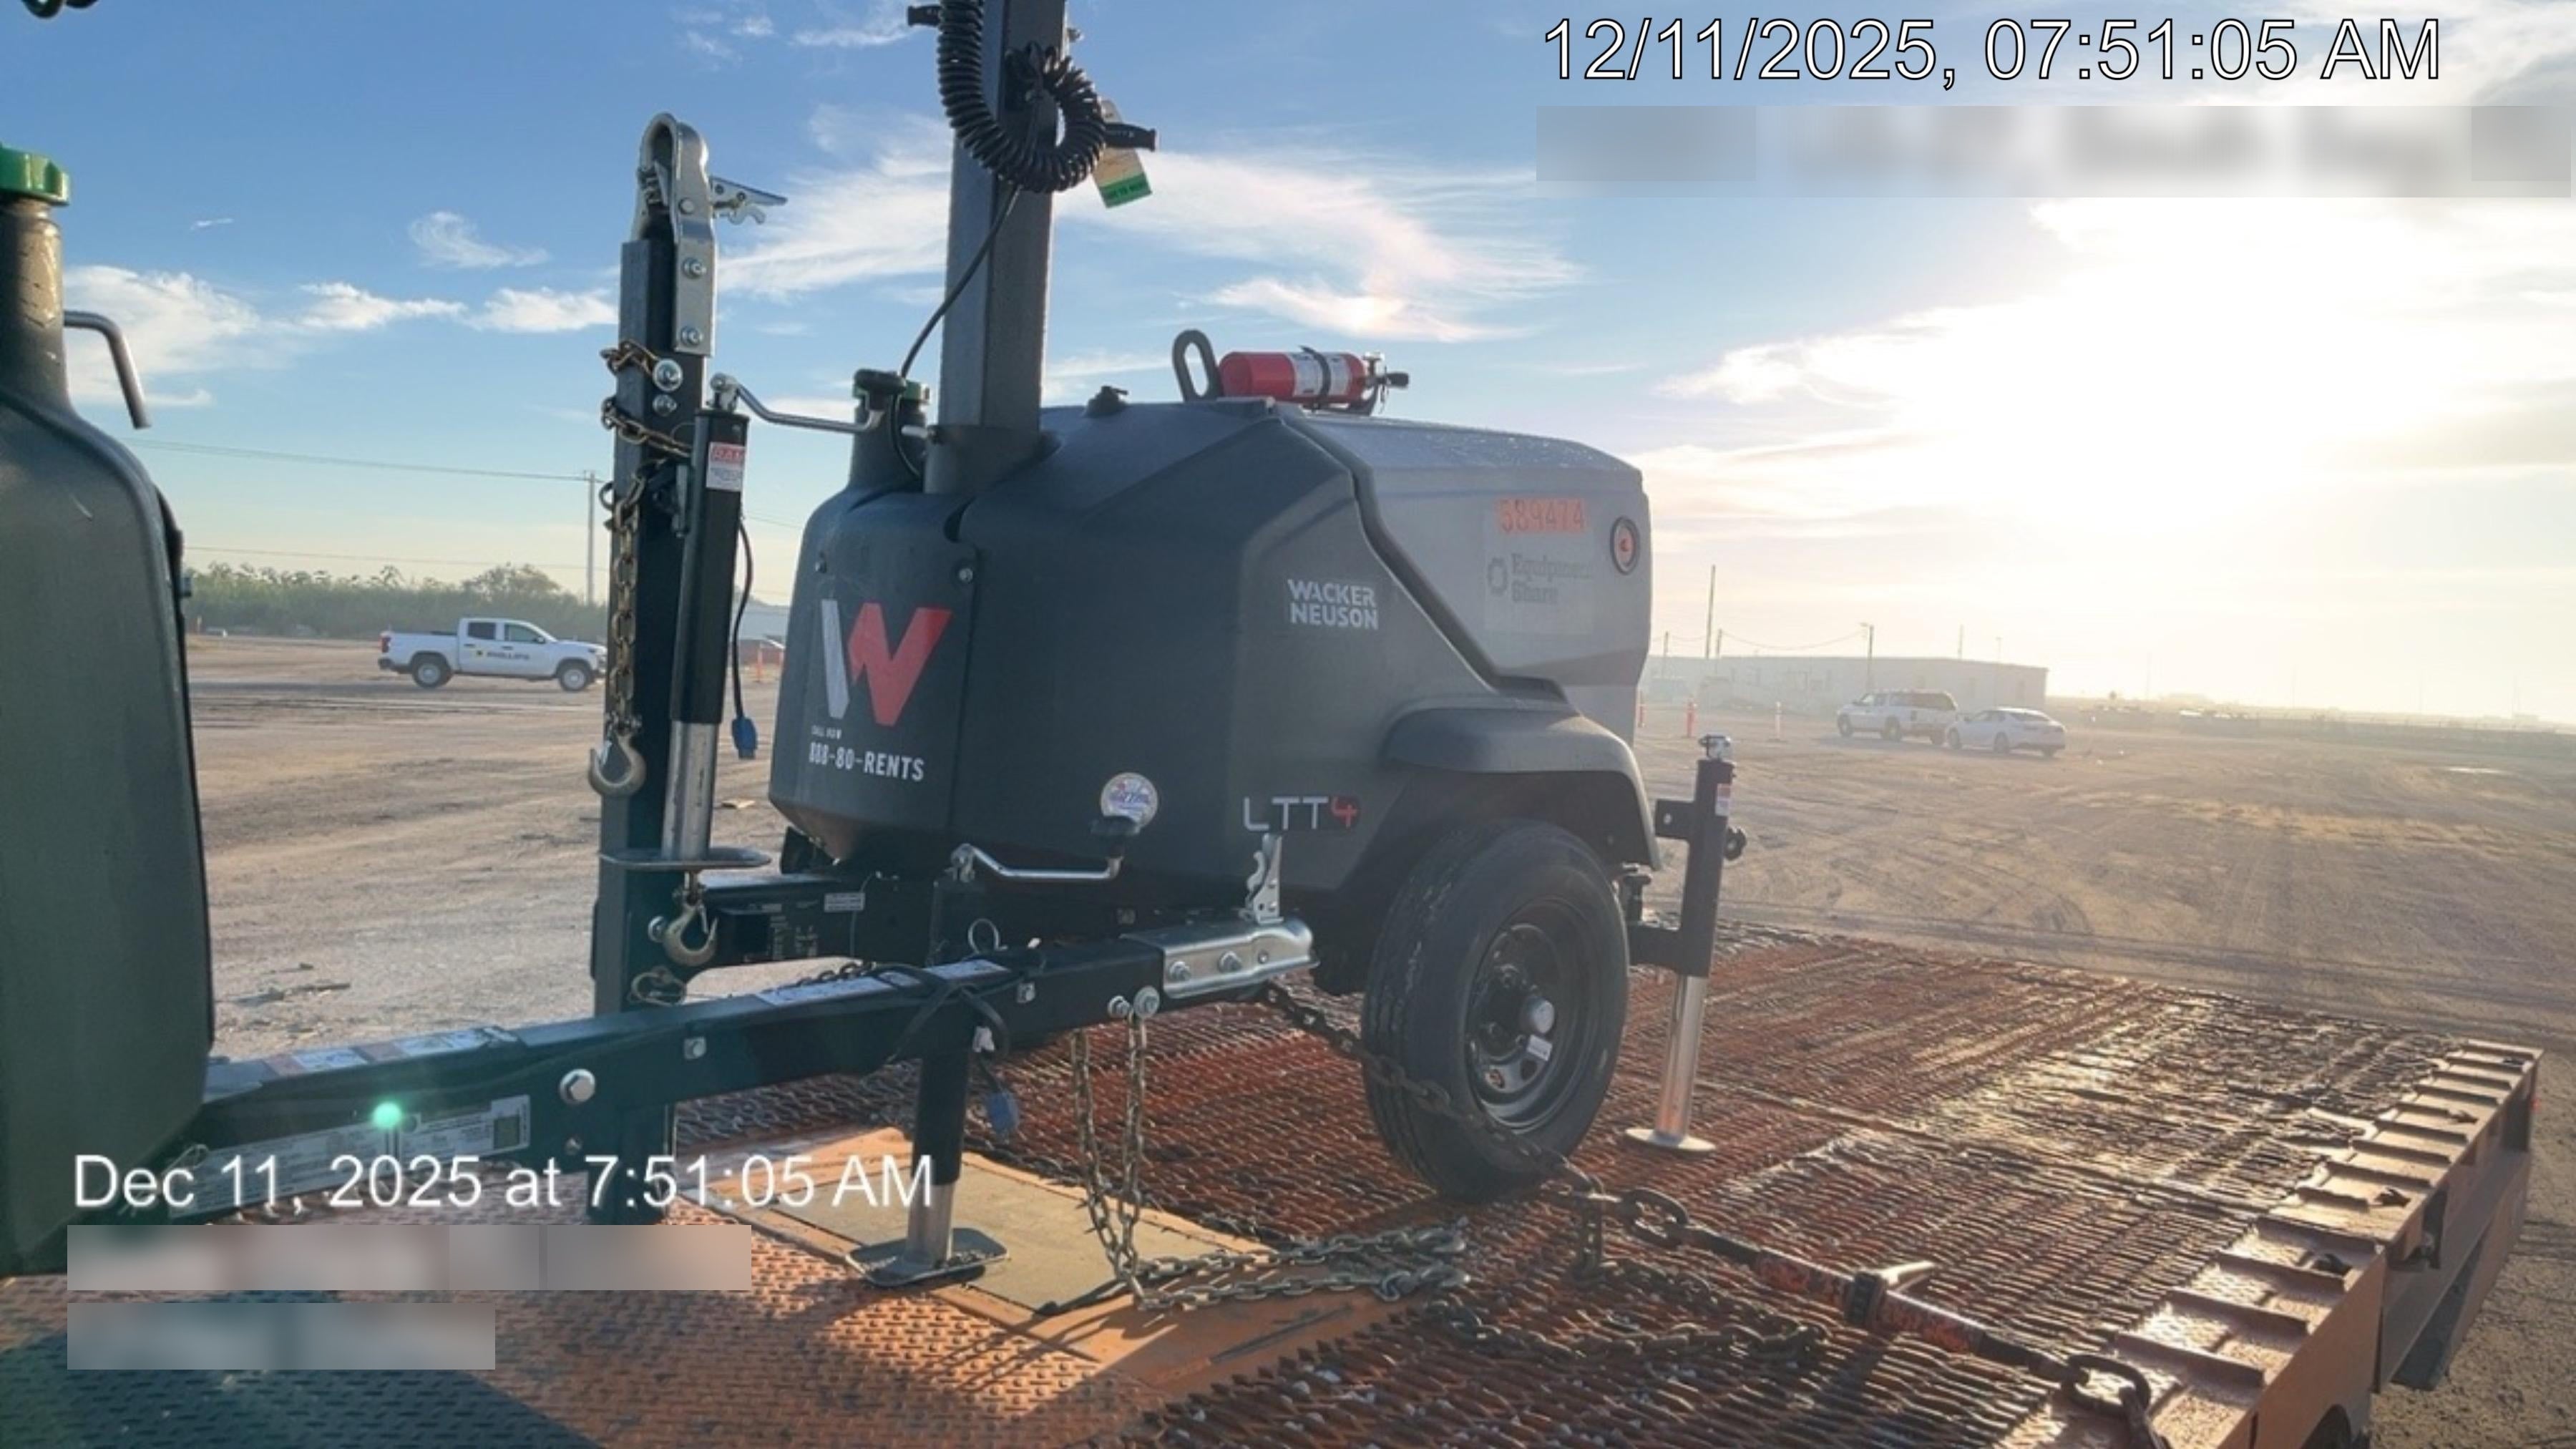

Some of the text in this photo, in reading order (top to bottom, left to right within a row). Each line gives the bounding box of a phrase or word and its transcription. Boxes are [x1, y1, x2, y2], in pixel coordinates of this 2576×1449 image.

[1287, 579, 1377, 608] WACKER
[1290, 602, 1380, 630] NEUSON
[809, 741, 925, 782] 888-80-RENTS
[1243, 796, 1358, 831] LTT4
